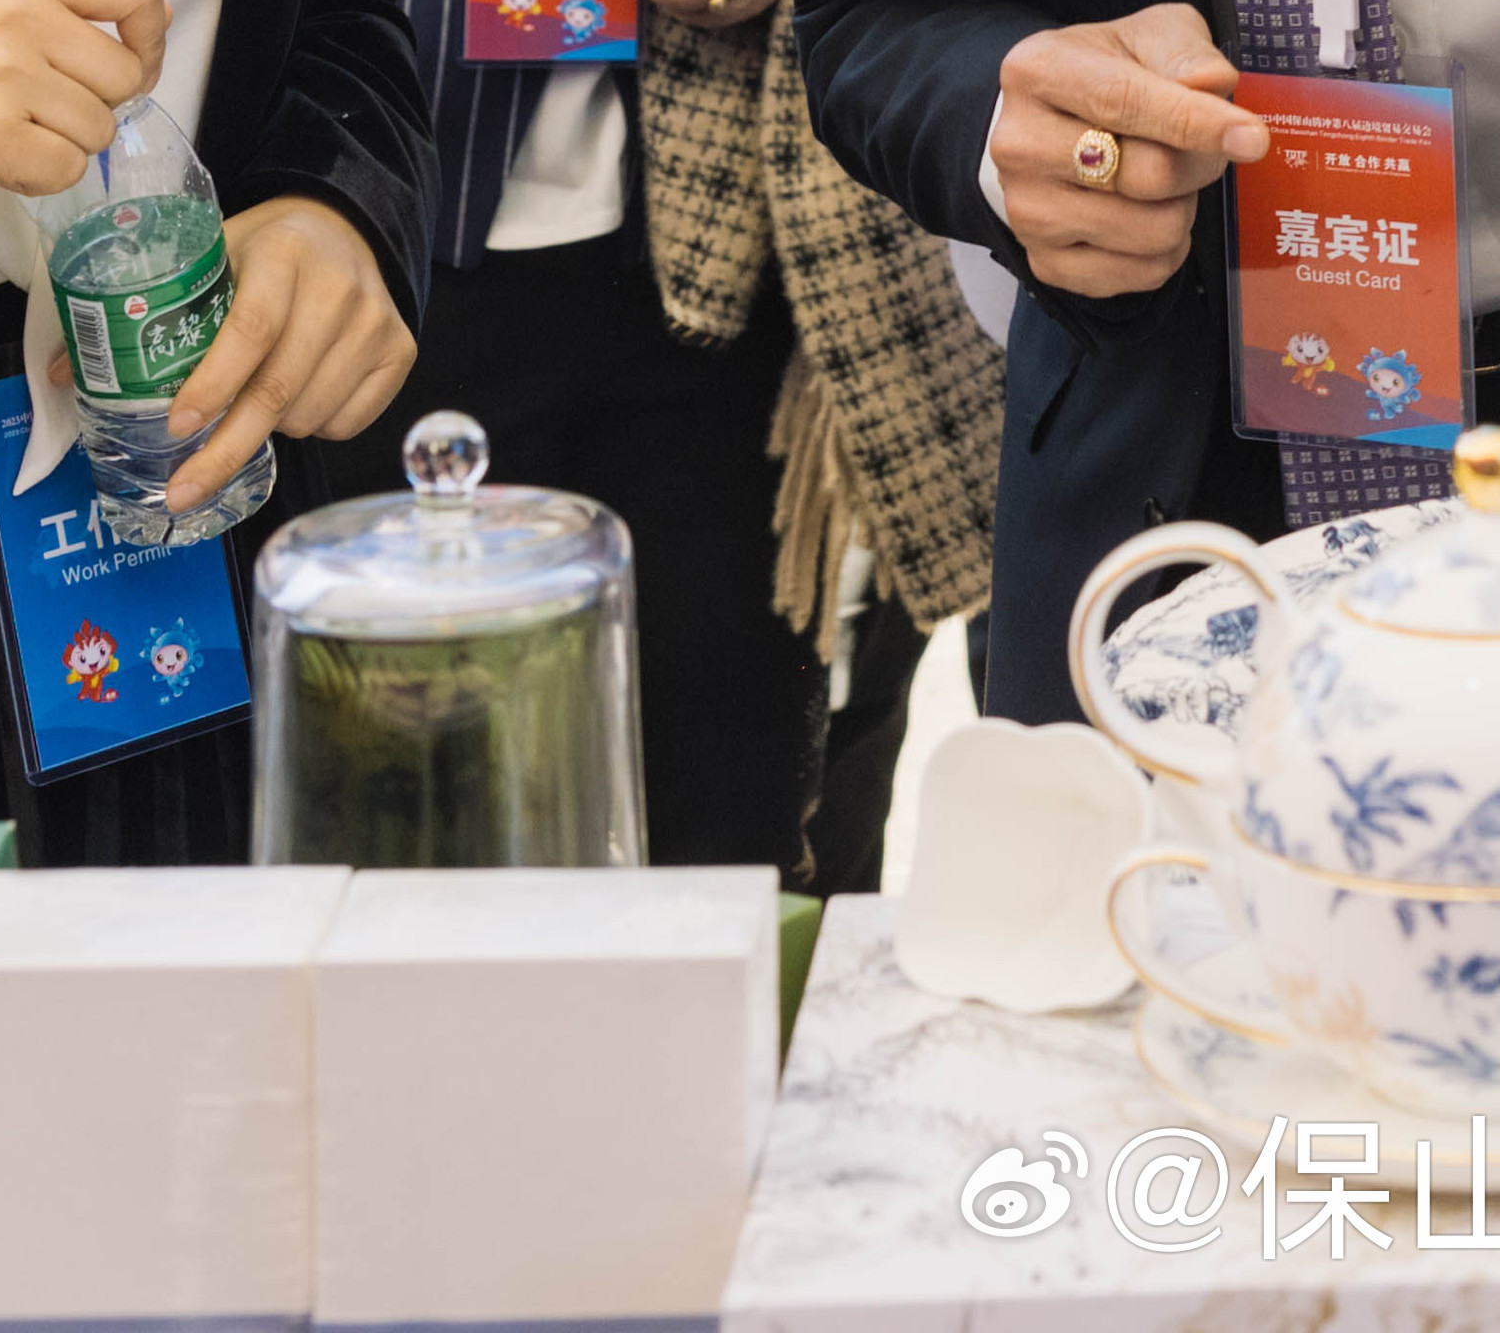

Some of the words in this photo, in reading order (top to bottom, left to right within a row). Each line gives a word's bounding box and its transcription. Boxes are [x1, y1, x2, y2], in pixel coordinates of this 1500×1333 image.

[1275, 208, 1421, 267] 嘉宾证
[1295, 264, 1352, 287] Guest
[1355, 269, 1402, 291] Card
[61, 559, 110, 585] Work
[113, 546, 173, 571] Permit
